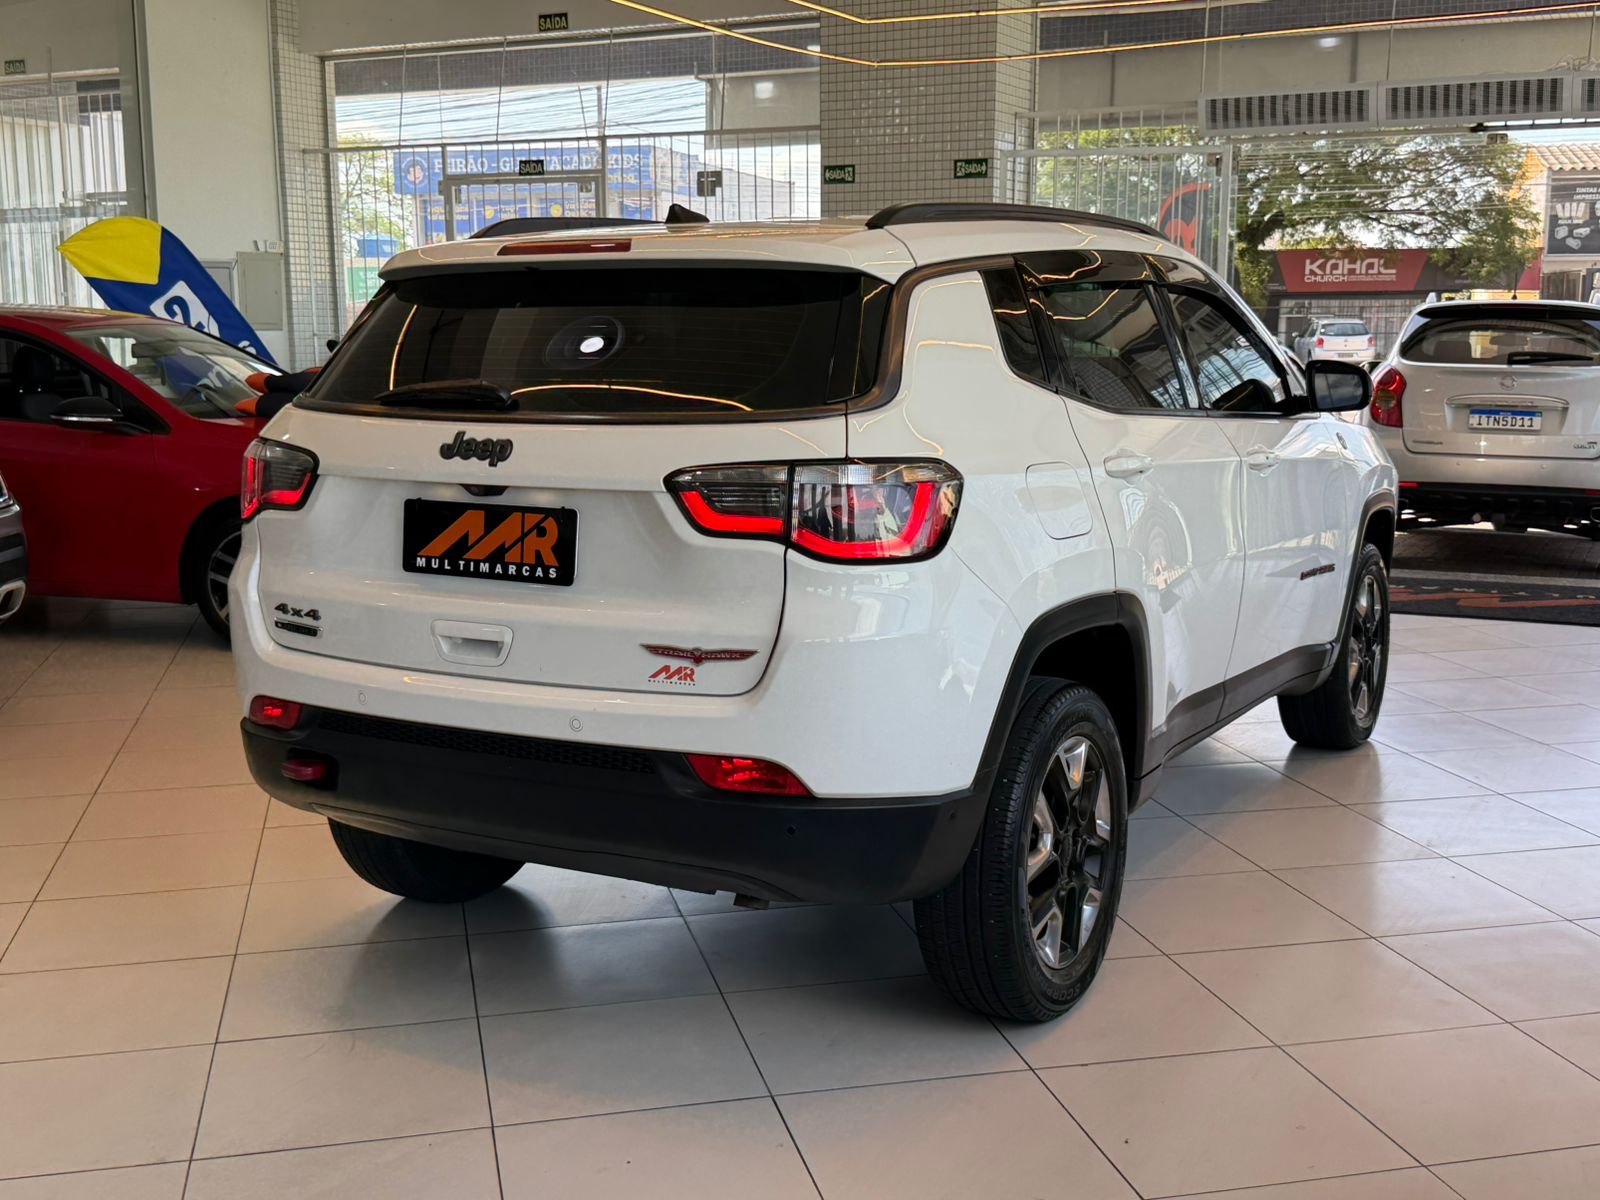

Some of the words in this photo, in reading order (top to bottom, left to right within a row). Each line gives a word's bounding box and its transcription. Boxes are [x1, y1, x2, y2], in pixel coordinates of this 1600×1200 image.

[539, 15, 567, 30] SAÍDA
[520, 161, 543, 174] SAÍDA
[1305, 258, 1397, 275] KAHAL
[1304, 275, 1348, 283] CHURCH
[1476, 416, 1535, 428] ITN5D11
[439, 431, 514, 467] Jeep
[416, 556, 558, 579] MULTIMARCAS
[274, 603, 322, 621] 4x4
